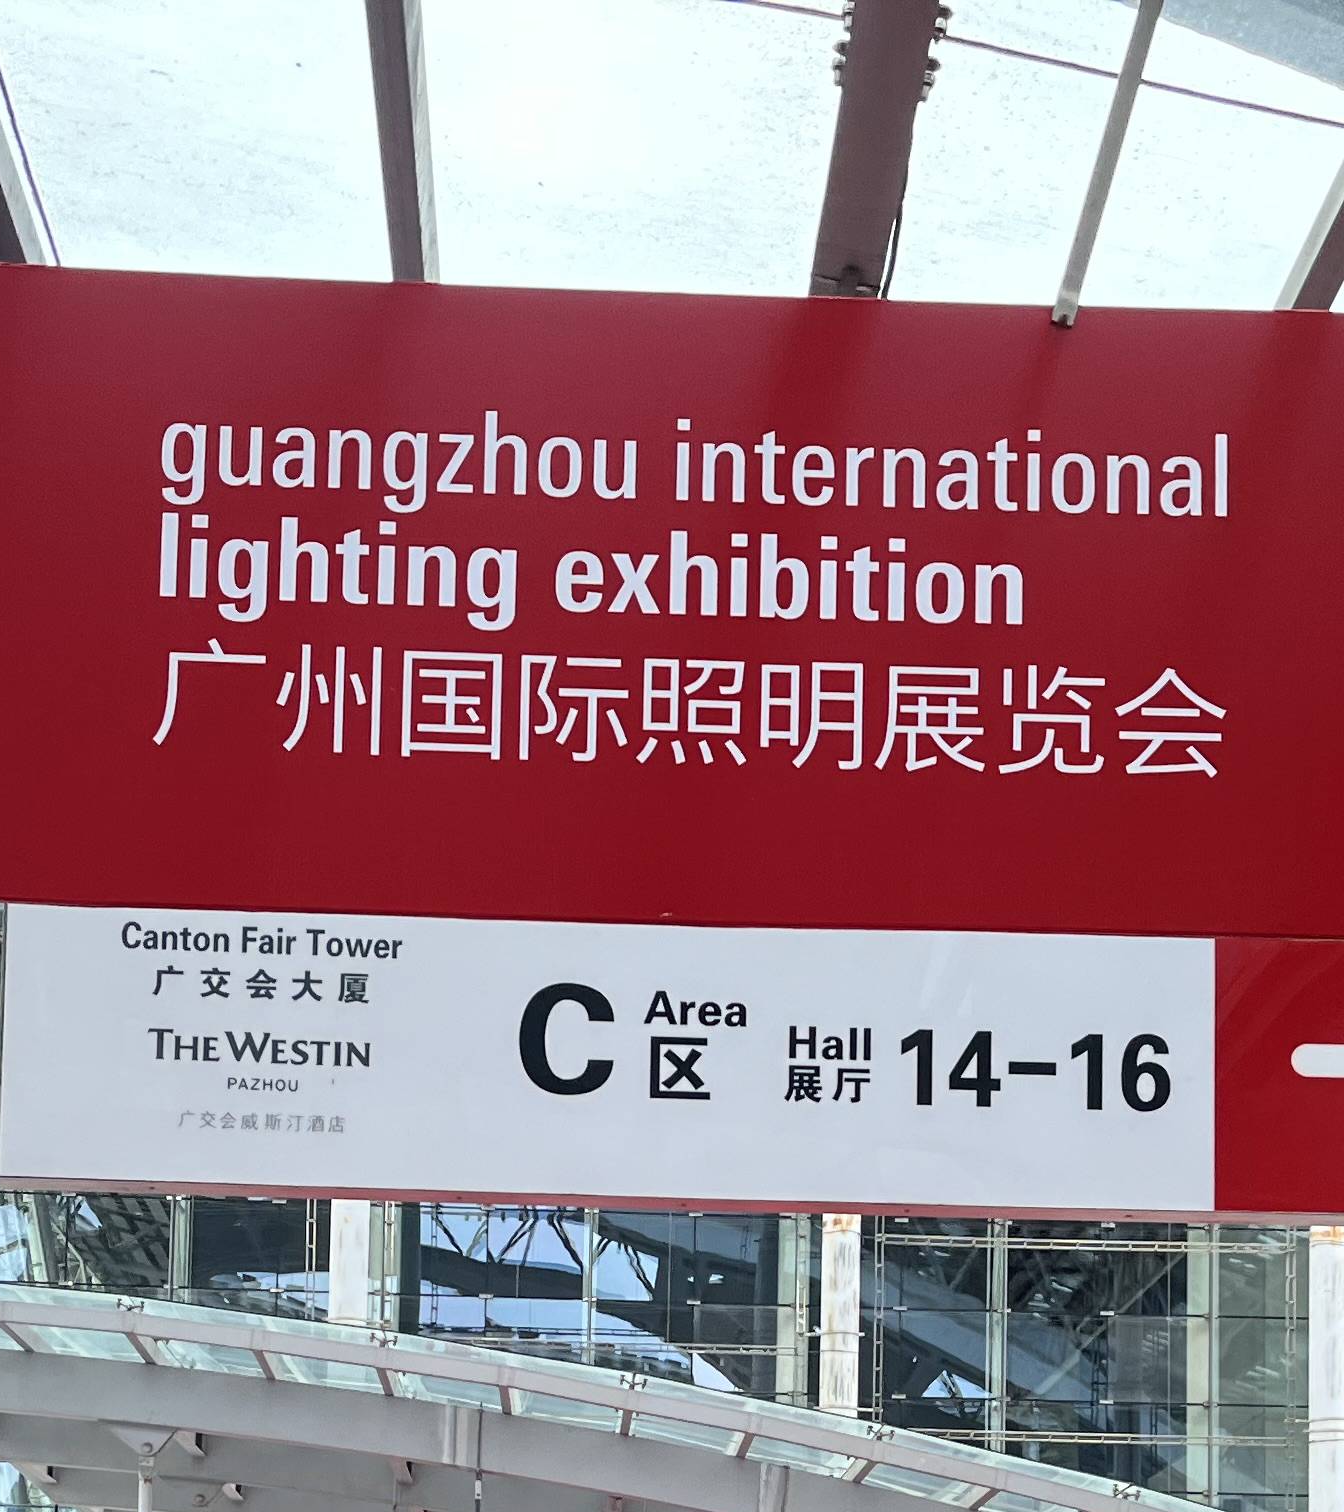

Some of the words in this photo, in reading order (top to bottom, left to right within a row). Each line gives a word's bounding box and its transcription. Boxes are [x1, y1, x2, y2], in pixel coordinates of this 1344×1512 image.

[160, 411, 639, 511] guangzhou
[676, 419, 1230, 518] international
[158, 513, 518, 631] lighting
[555, 530, 1024, 626] exhibition
[153, 638, 1229, 778] 广州国际照明展览会
[120, 920, 231, 955] Canton
[240, 925, 297, 957] Fair
[307, 928, 404, 961] Tower
[152, 966, 370, 1005] 广交会大厦
[518, 982, 616, 1097] C
[643, 990, 749, 1028] Area
[788, 1025, 872, 1062] Hall
[226, 1077, 300, 1094] PAZHOU
[649, 1036, 711, 1101] 区
[784, 1065, 872, 1104] 展厅
[178, 1110, 346, 1135] 广交会威斯汀酒店
